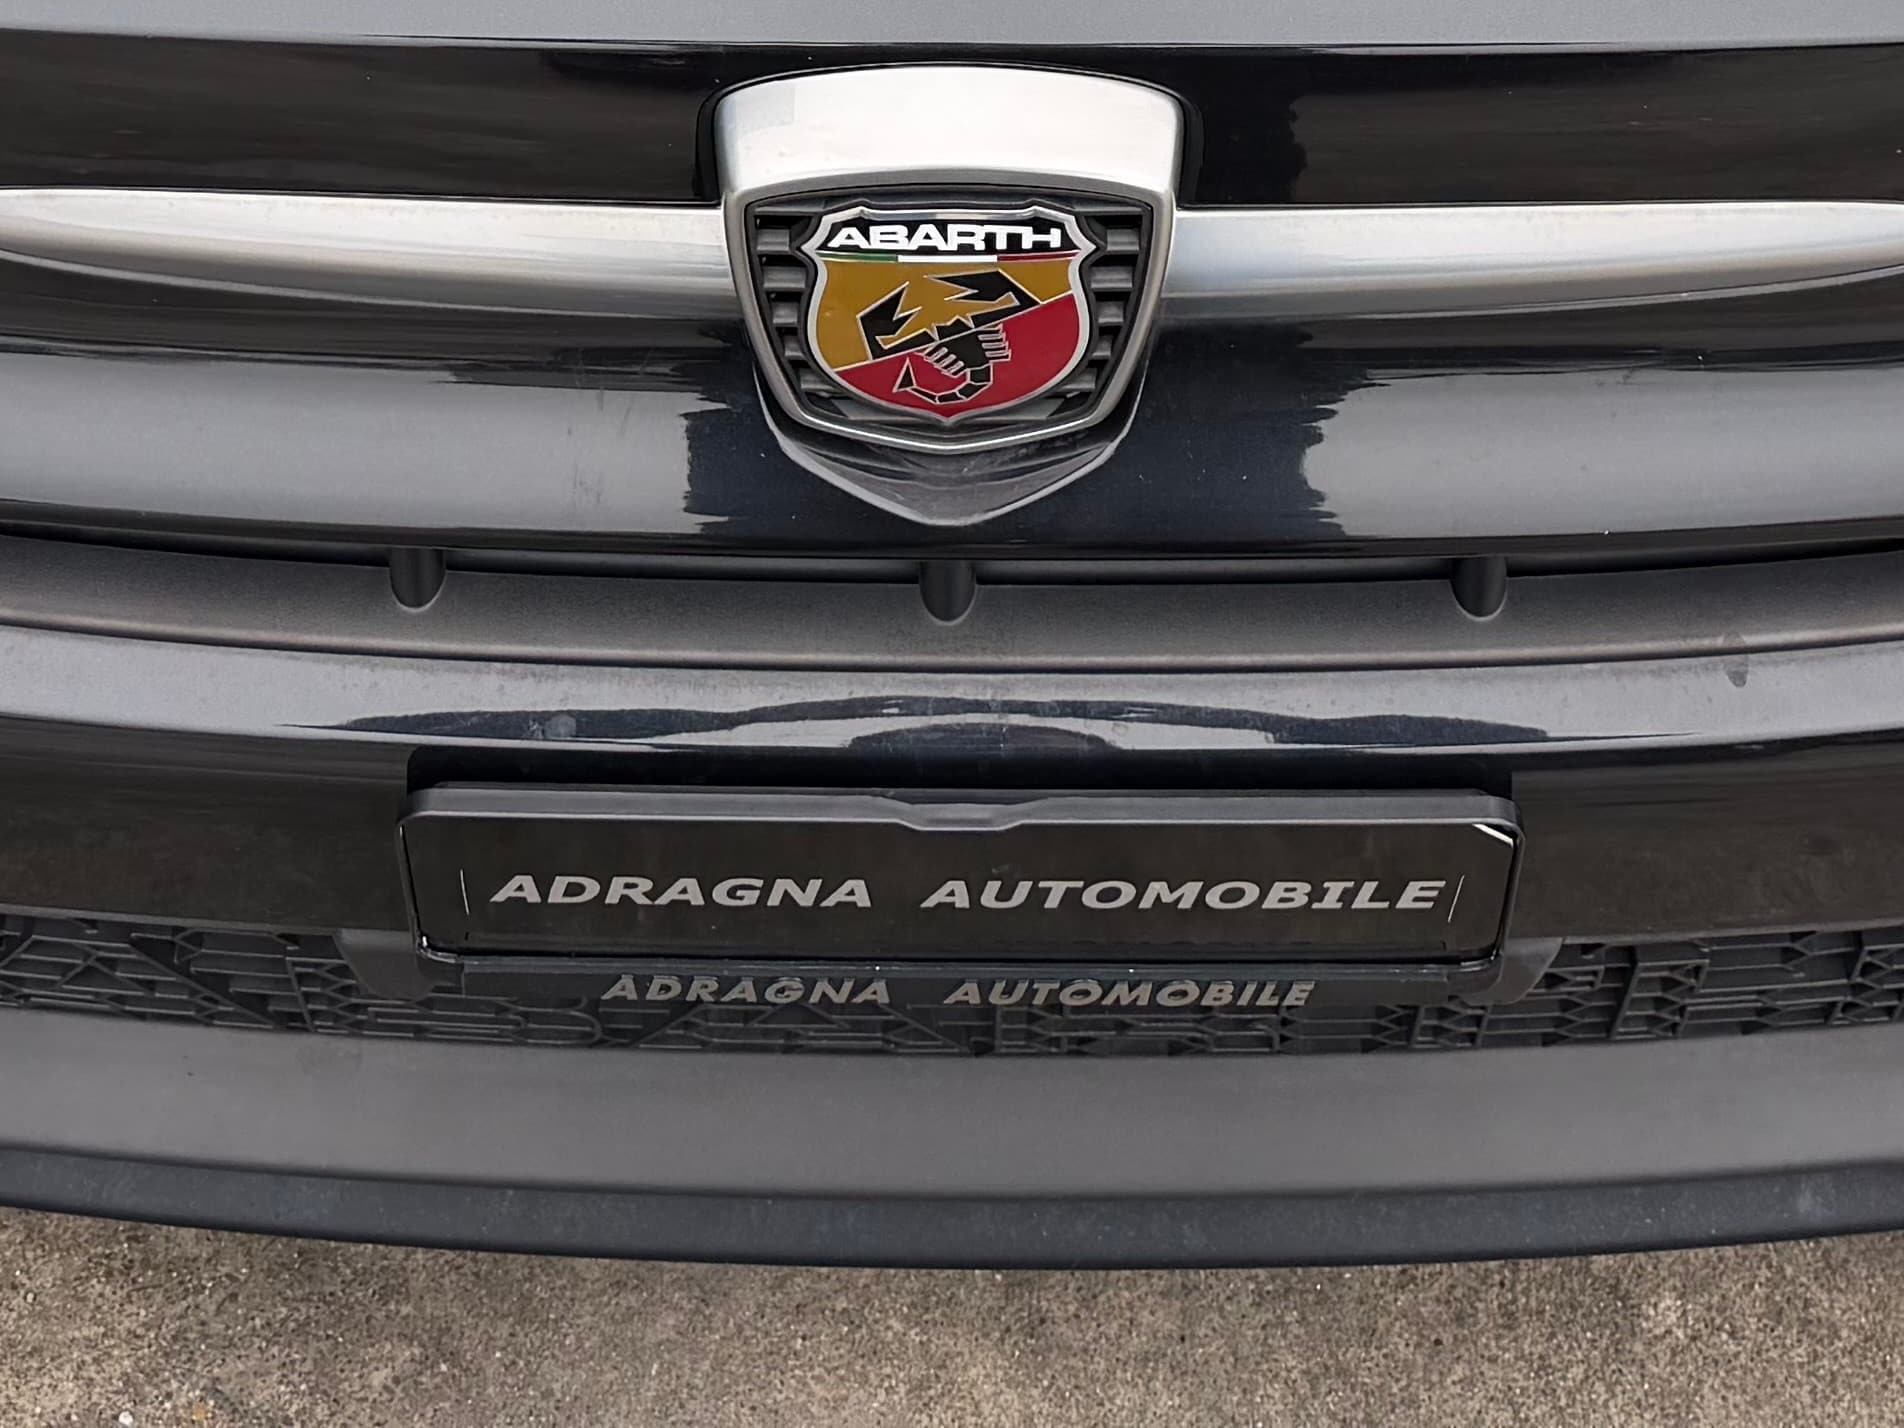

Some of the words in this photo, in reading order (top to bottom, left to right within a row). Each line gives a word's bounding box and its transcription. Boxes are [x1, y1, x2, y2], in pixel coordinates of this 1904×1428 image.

[826, 223, 1062, 251] ABARTH
[491, 876, 870, 906] ADRAGNA
[921, 881, 1445, 908] AUTOMOBILE
[602, 976, 889, 1003] ADRAGNA
[944, 980, 1314, 1006] AUTOMOBILE
